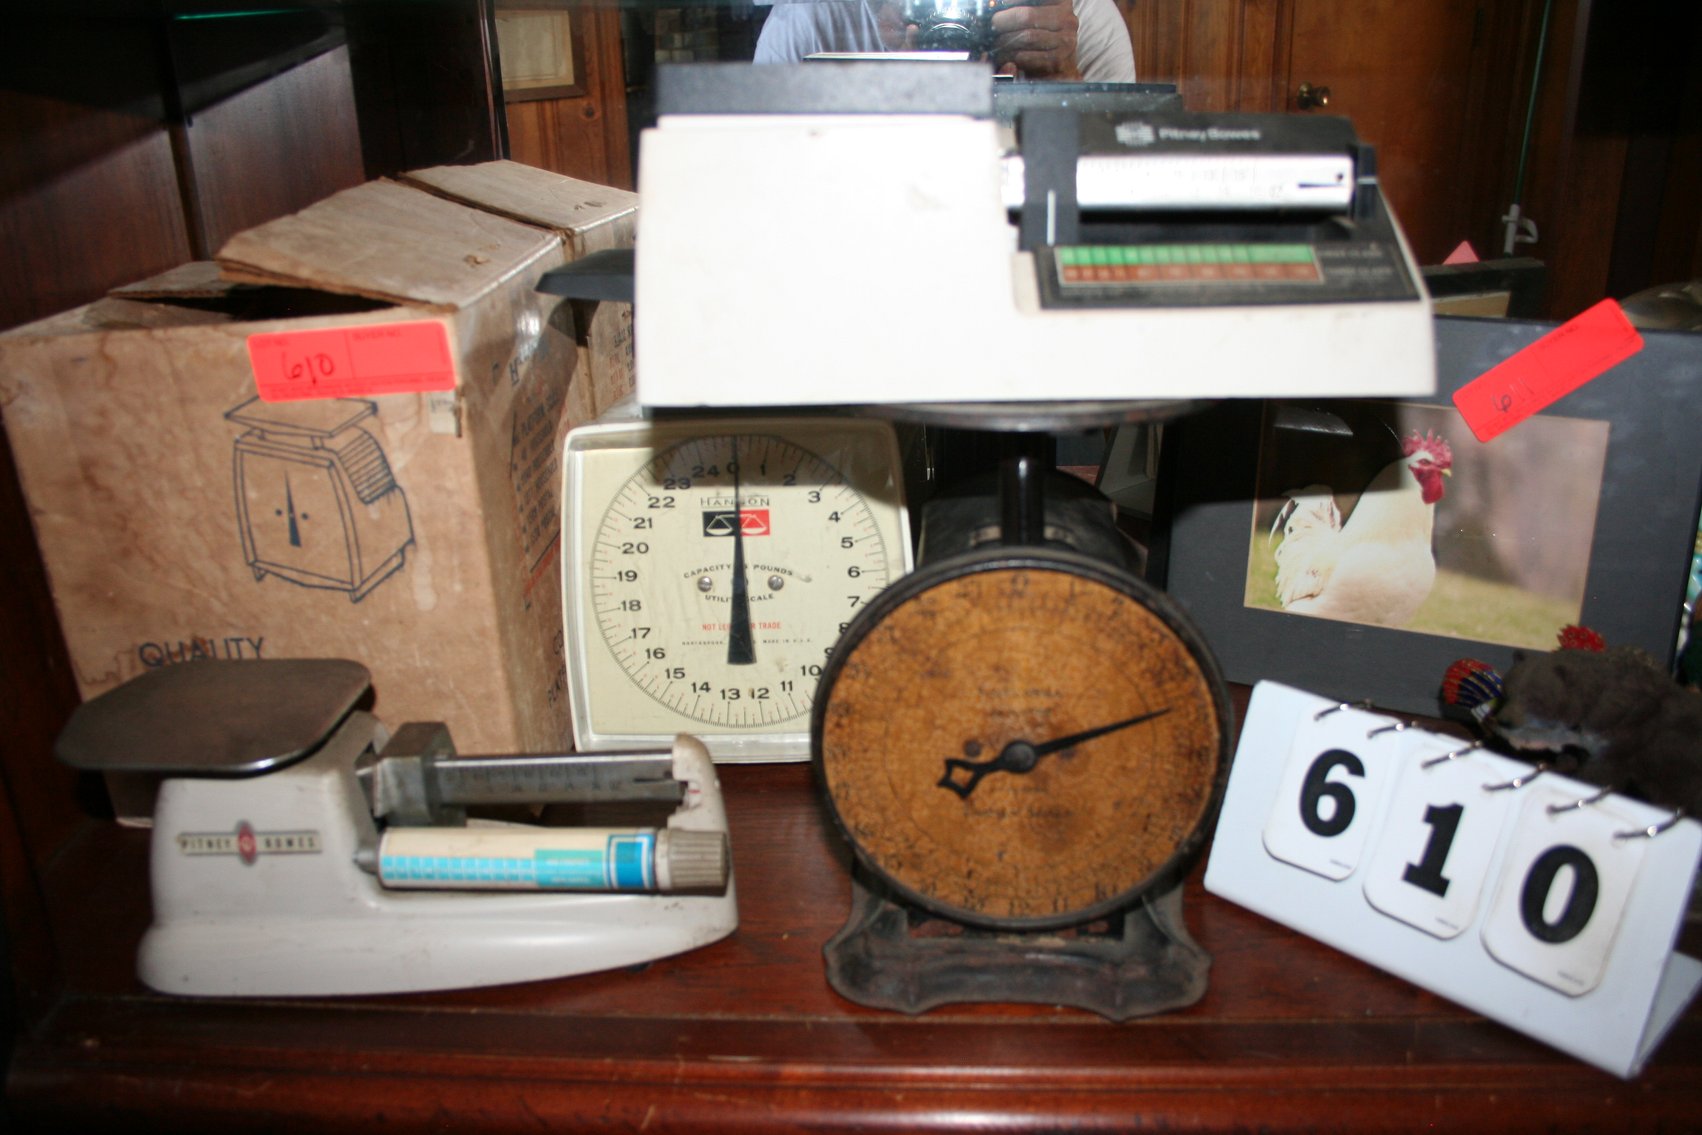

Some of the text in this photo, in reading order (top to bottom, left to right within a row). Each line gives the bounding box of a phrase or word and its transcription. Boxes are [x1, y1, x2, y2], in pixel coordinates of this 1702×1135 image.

[281, 351, 335, 388] 610
[692, 464, 720, 478] 24
[663, 477, 691, 490] 23
[783, 473, 797, 486] 2
[648, 496, 676, 509] 22
[807, 490, 821, 504] 3
[633, 517, 653, 529] 21
[828, 511, 841, 523] 4
[622, 542, 649, 555] 20
[841, 536, 854, 549] 5
[618, 569, 638, 582] 19
[683, 563, 732, 579] CAPACITY
[753, 563, 793, 577] POUNDS
[847, 565, 861, 578] 6
[747, 593, 774, 603] CALE
[847, 595, 860, 608] 7
[620, 599, 642, 612] 18
[631, 627, 651, 640] 17
[702, 623, 716, 632] NOT
[759, 622, 782, 630] TRADE
[139, 636, 264, 667] QUALITY
[645, 647, 666, 660] 16
[665, 667, 686, 680] 15
[801, 664, 822, 677] 10
[691, 681, 711, 693] 14
[780, 680, 793, 692] 11
[720, 688, 741, 701] 13
[750, 688, 770, 700] 12
